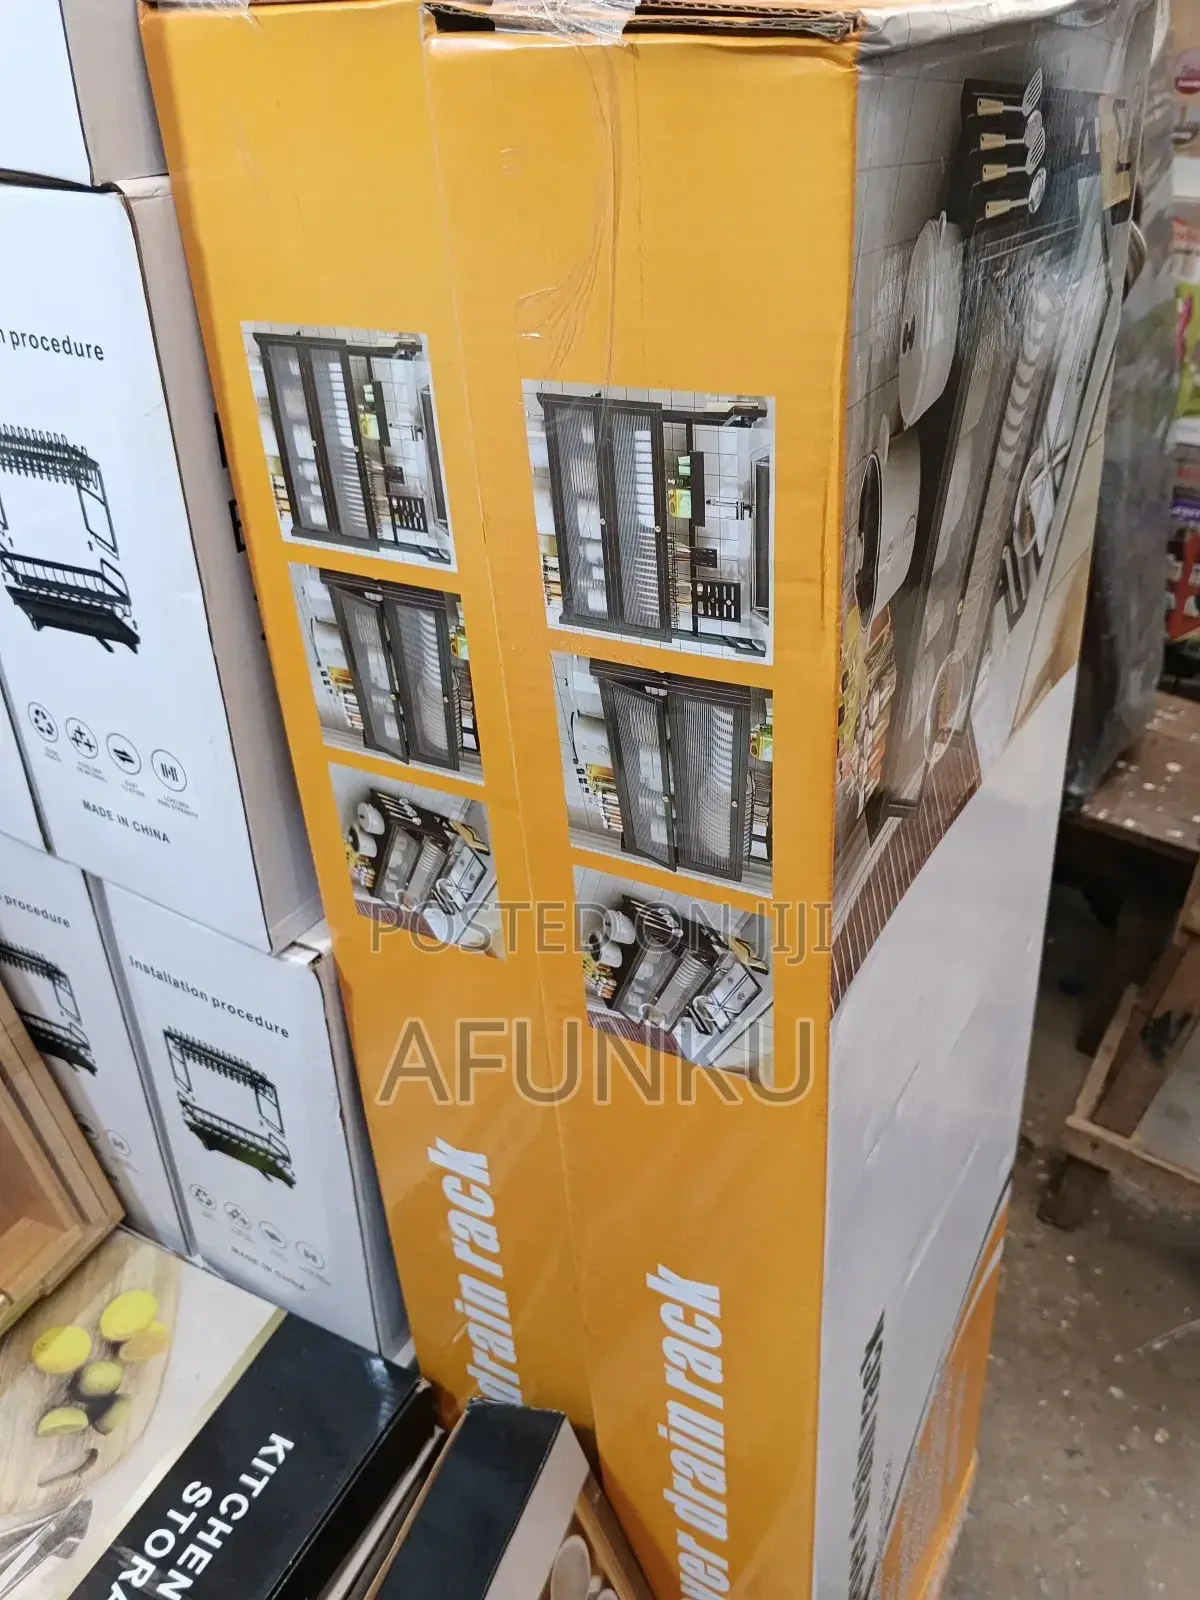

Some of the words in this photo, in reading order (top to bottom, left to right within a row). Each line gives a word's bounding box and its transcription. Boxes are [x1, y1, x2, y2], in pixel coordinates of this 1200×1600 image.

[9, 330, 105, 362] procedure
[82, 799, 114, 821] MADE
[116, 814, 129, 828] IN
[132, 821, 171, 844] CHINA
[3, 894, 71, 929] procedure
[211, 996, 290, 1039] procedure
[427, 1136, 504, 1280] rack
[453, 1272, 524, 1406] drain
[645, 1263, 724, 1410] rack
[156, 1432, 295, 1600] KITCHEN
[657, 1399, 729, 1542] drain
